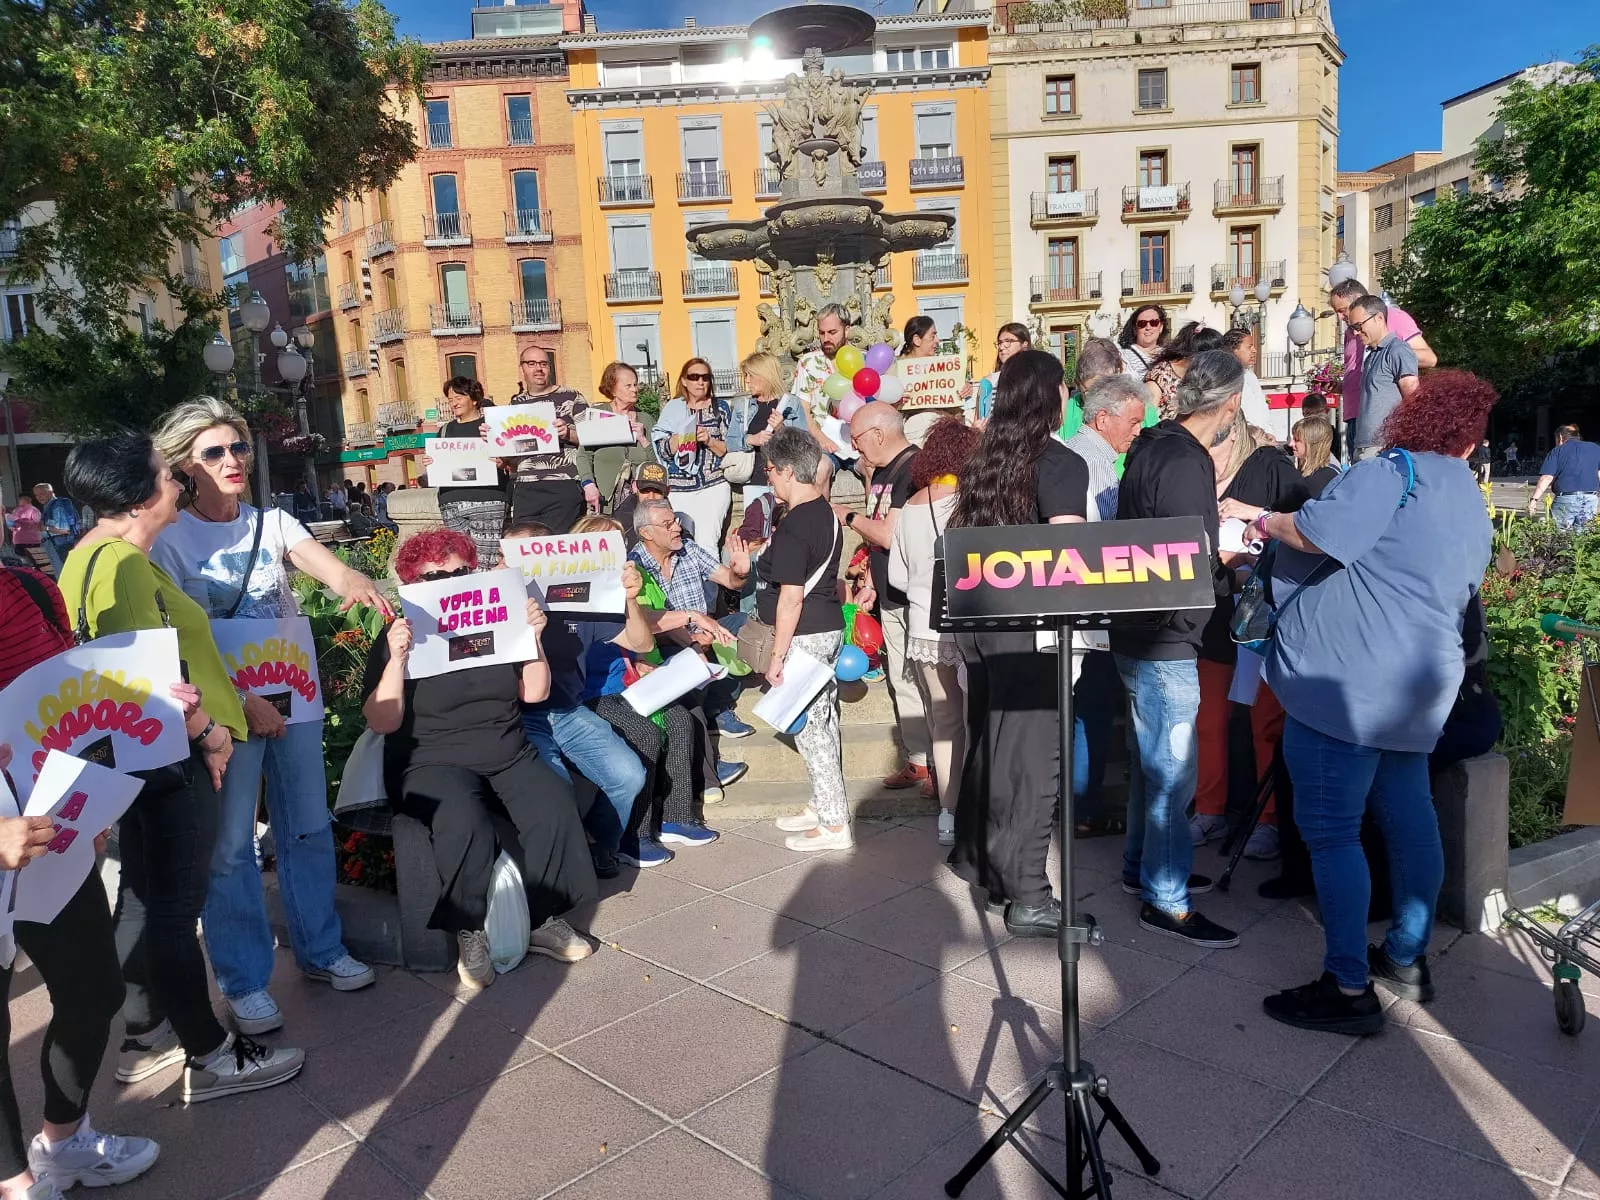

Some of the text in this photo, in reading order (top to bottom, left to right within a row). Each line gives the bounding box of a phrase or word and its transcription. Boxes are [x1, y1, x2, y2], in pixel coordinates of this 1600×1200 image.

[912, 166, 927, 176] 611
[906, 359, 961, 376] ESTAMOS
[904, 378, 956, 394] CONTIGO
[434, 440, 476, 452] LORENA
[519, 537, 609, 557] LORENA A
[520, 550, 616, 578] LA FINAL!!!
[955, 542, 1200, 591] JOTALENT
[439, 587, 501, 613] VOTA A
[438, 605, 509, 634] LORENA
[224, 638, 310, 673] LORENA
[230, 661, 317, 703] NADORA
[24, 668, 154, 745] LORENA
[32, 698, 164, 784] ANADORA
